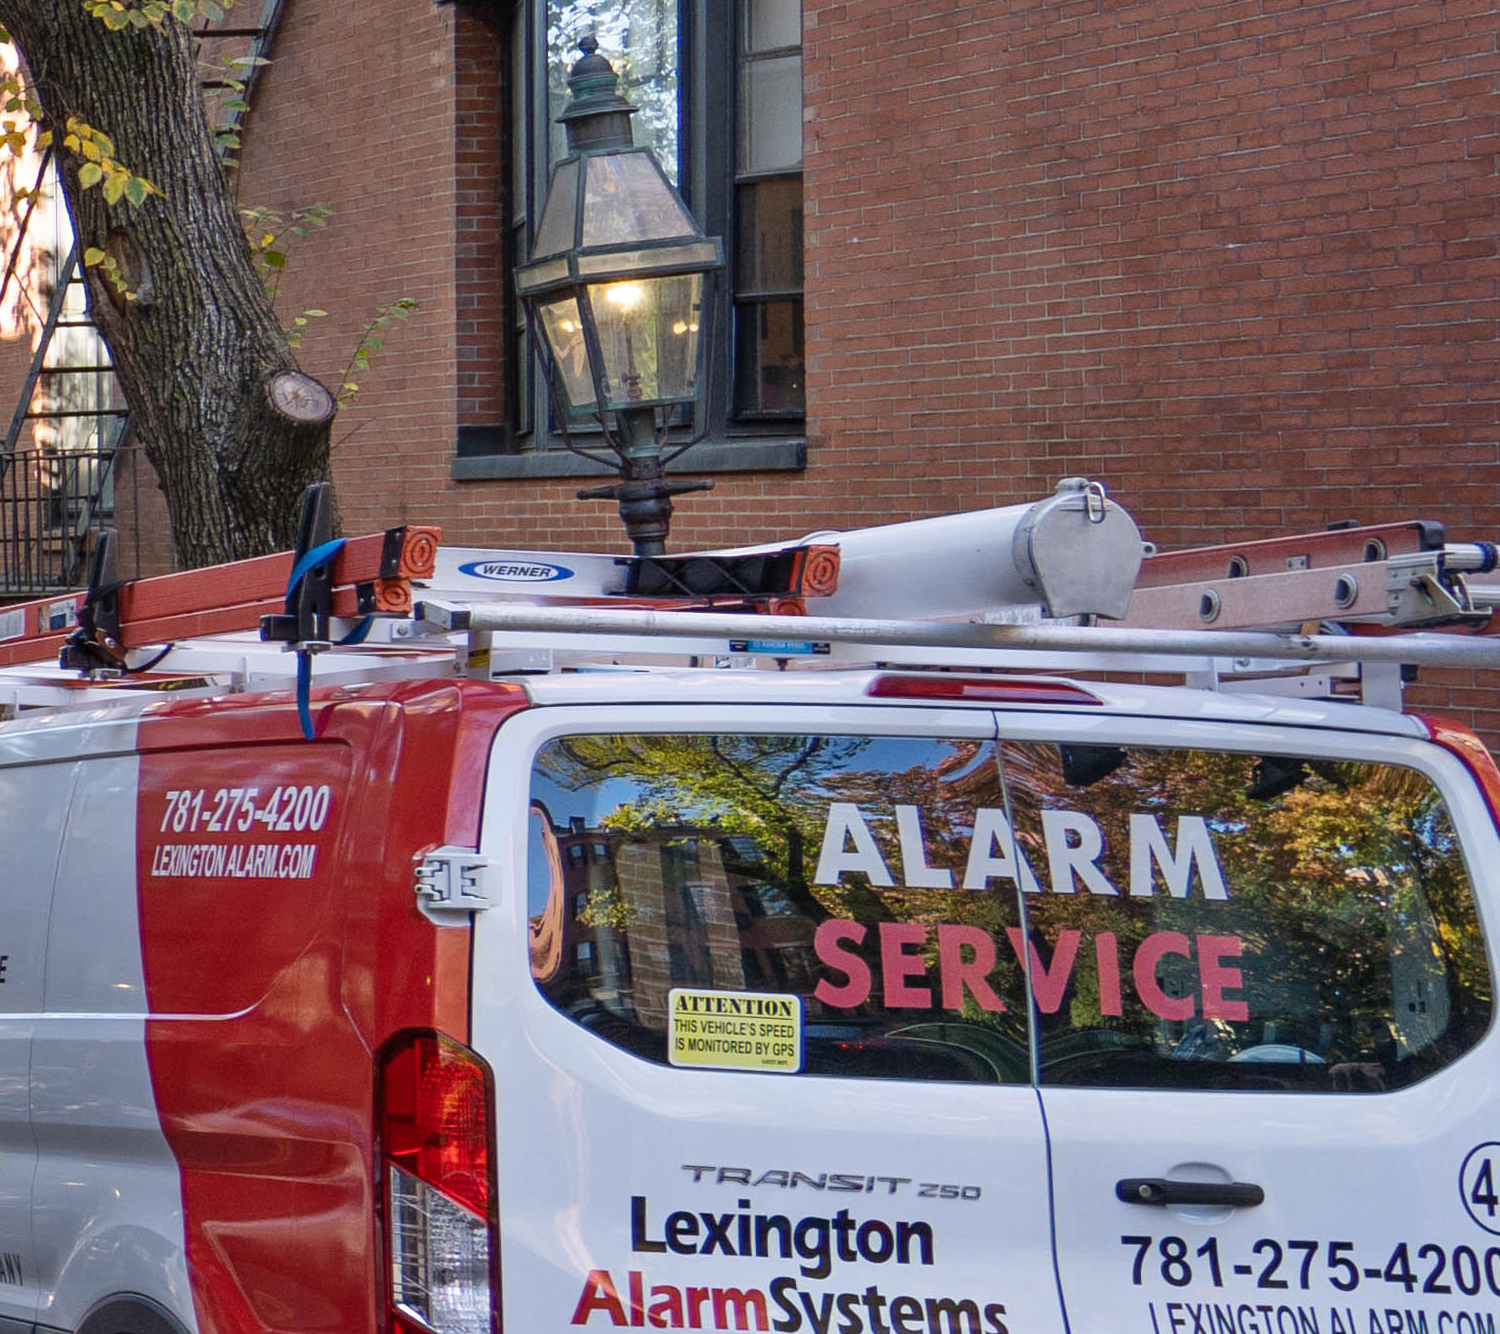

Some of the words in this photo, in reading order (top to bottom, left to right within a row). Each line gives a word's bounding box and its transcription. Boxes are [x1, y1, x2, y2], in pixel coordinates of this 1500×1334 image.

[483, 564, 551, 577] WERNER
[160, 785, 330, 833] 781-275-4200
[151, 845, 227, 877] LEXINGTON
[224, 844, 317, 879] ALARM.COM
[813, 802, 1229, 901] ALARM
[813, 918, 1250, 1022] SERVICE
[675, 995, 793, 1017] ATTENTION
[674, 1018, 697, 1033] THIS
[700, 1020, 757, 1037] VEHICLE'S
[759, 1023, 794, 1038] SPEED
[675, 1037, 685, 1051] IS
[687, 1038, 752, 1054] MONITORED
[755, 1041, 770, 1055] BY
[773, 1042, 795, 1057] GPS
[681, 1164, 912, 1195] TRANSIT
[917, 1182, 982, 1201] 250
[631, 1195, 935, 1279] Lexington
